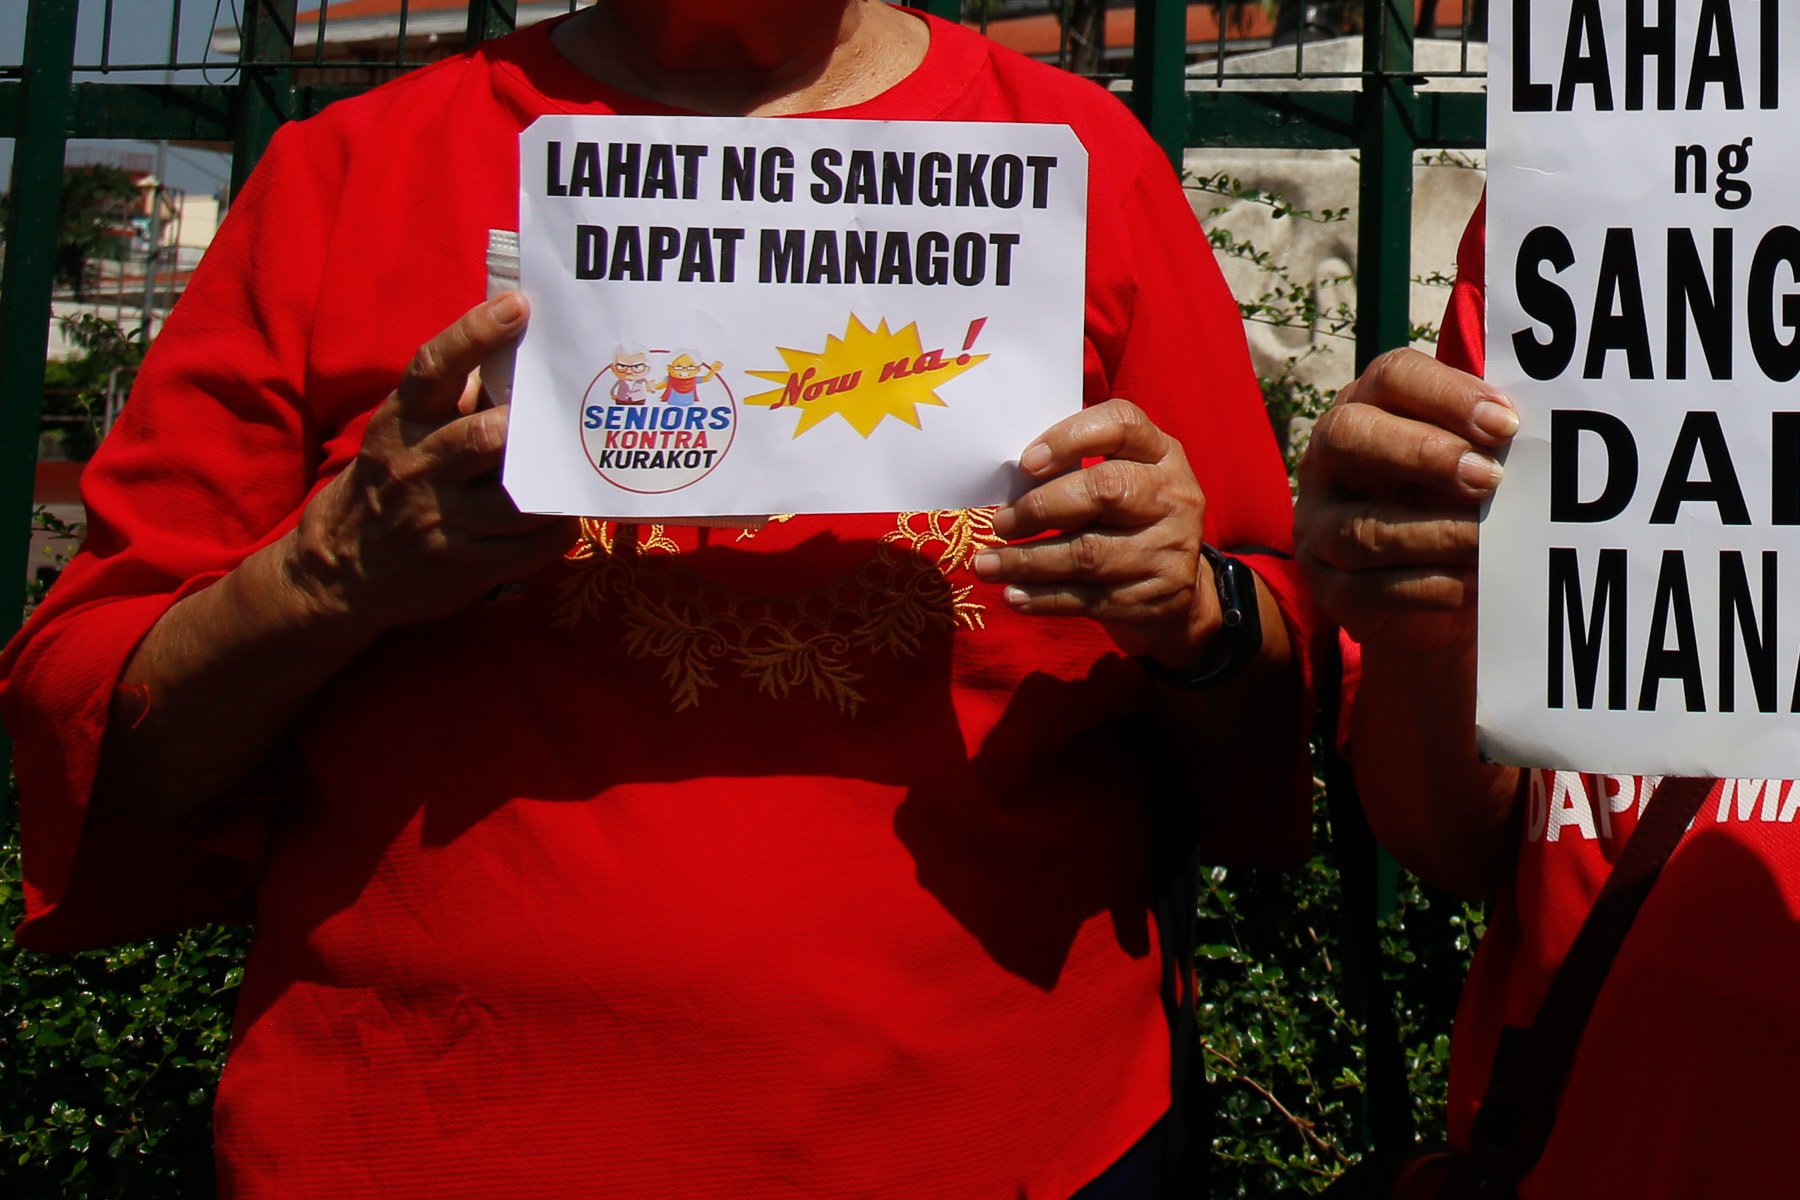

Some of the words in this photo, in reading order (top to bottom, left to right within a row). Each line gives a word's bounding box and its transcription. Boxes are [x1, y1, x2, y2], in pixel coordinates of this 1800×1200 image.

[546, 141, 708, 198] LAHAT
[721, 146, 795, 202] NG
[810, 148, 1058, 209] SANGKOT
[1674, 136, 1753, 210] ng
[575, 224, 745, 282] DAPAT
[758, 227, 1020, 286] MANAGOT
[769, 367, 860, 412] Now
[878, 316, 989, 385] na!
[584, 405, 732, 430] SENIORS
[605, 430, 709, 450] KONTRA
[598, 449, 718, 469] KURAKOT
[1528, 767, 1698, 843] DAP
